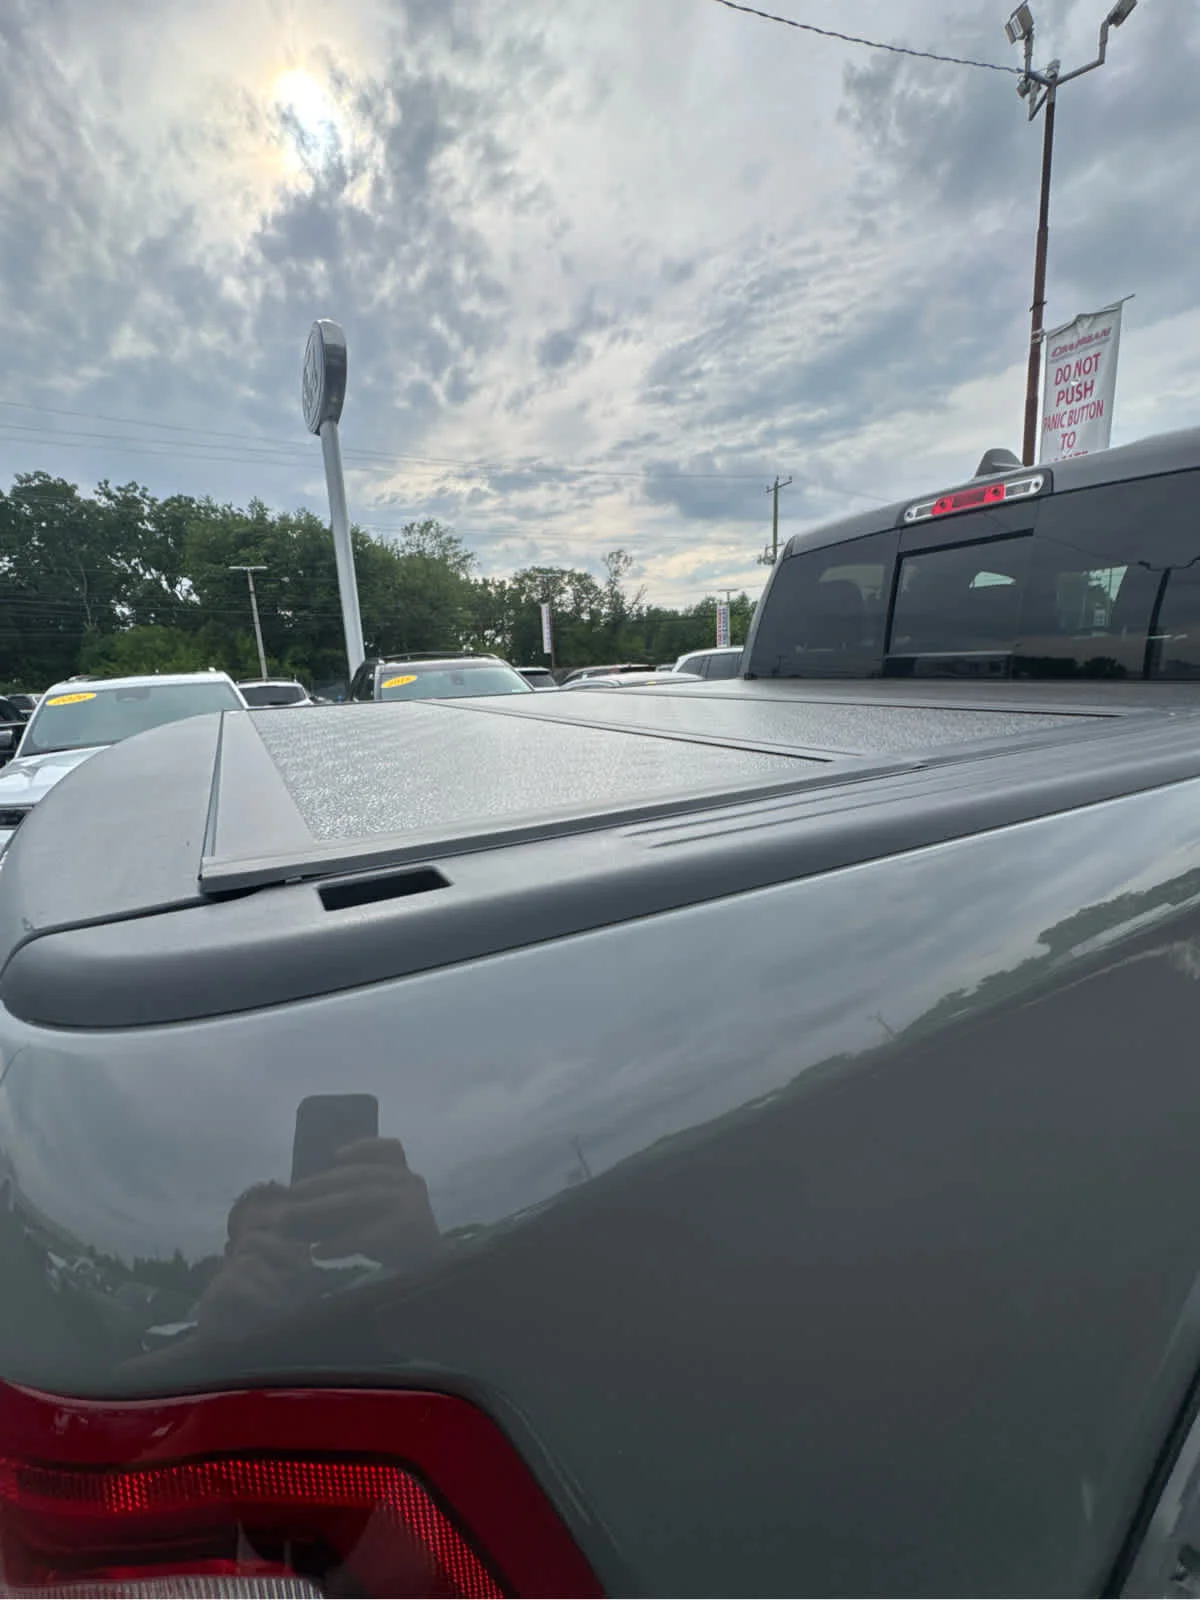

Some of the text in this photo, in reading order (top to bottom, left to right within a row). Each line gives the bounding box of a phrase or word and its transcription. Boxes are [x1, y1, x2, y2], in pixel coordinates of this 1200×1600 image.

[1055, 352, 1102, 386] DO NOT
[1056, 380, 1095, 407] PUSH
[1043, 399, 1104, 432] PANIC BUTTON
[1061, 431, 1076, 450] TO
